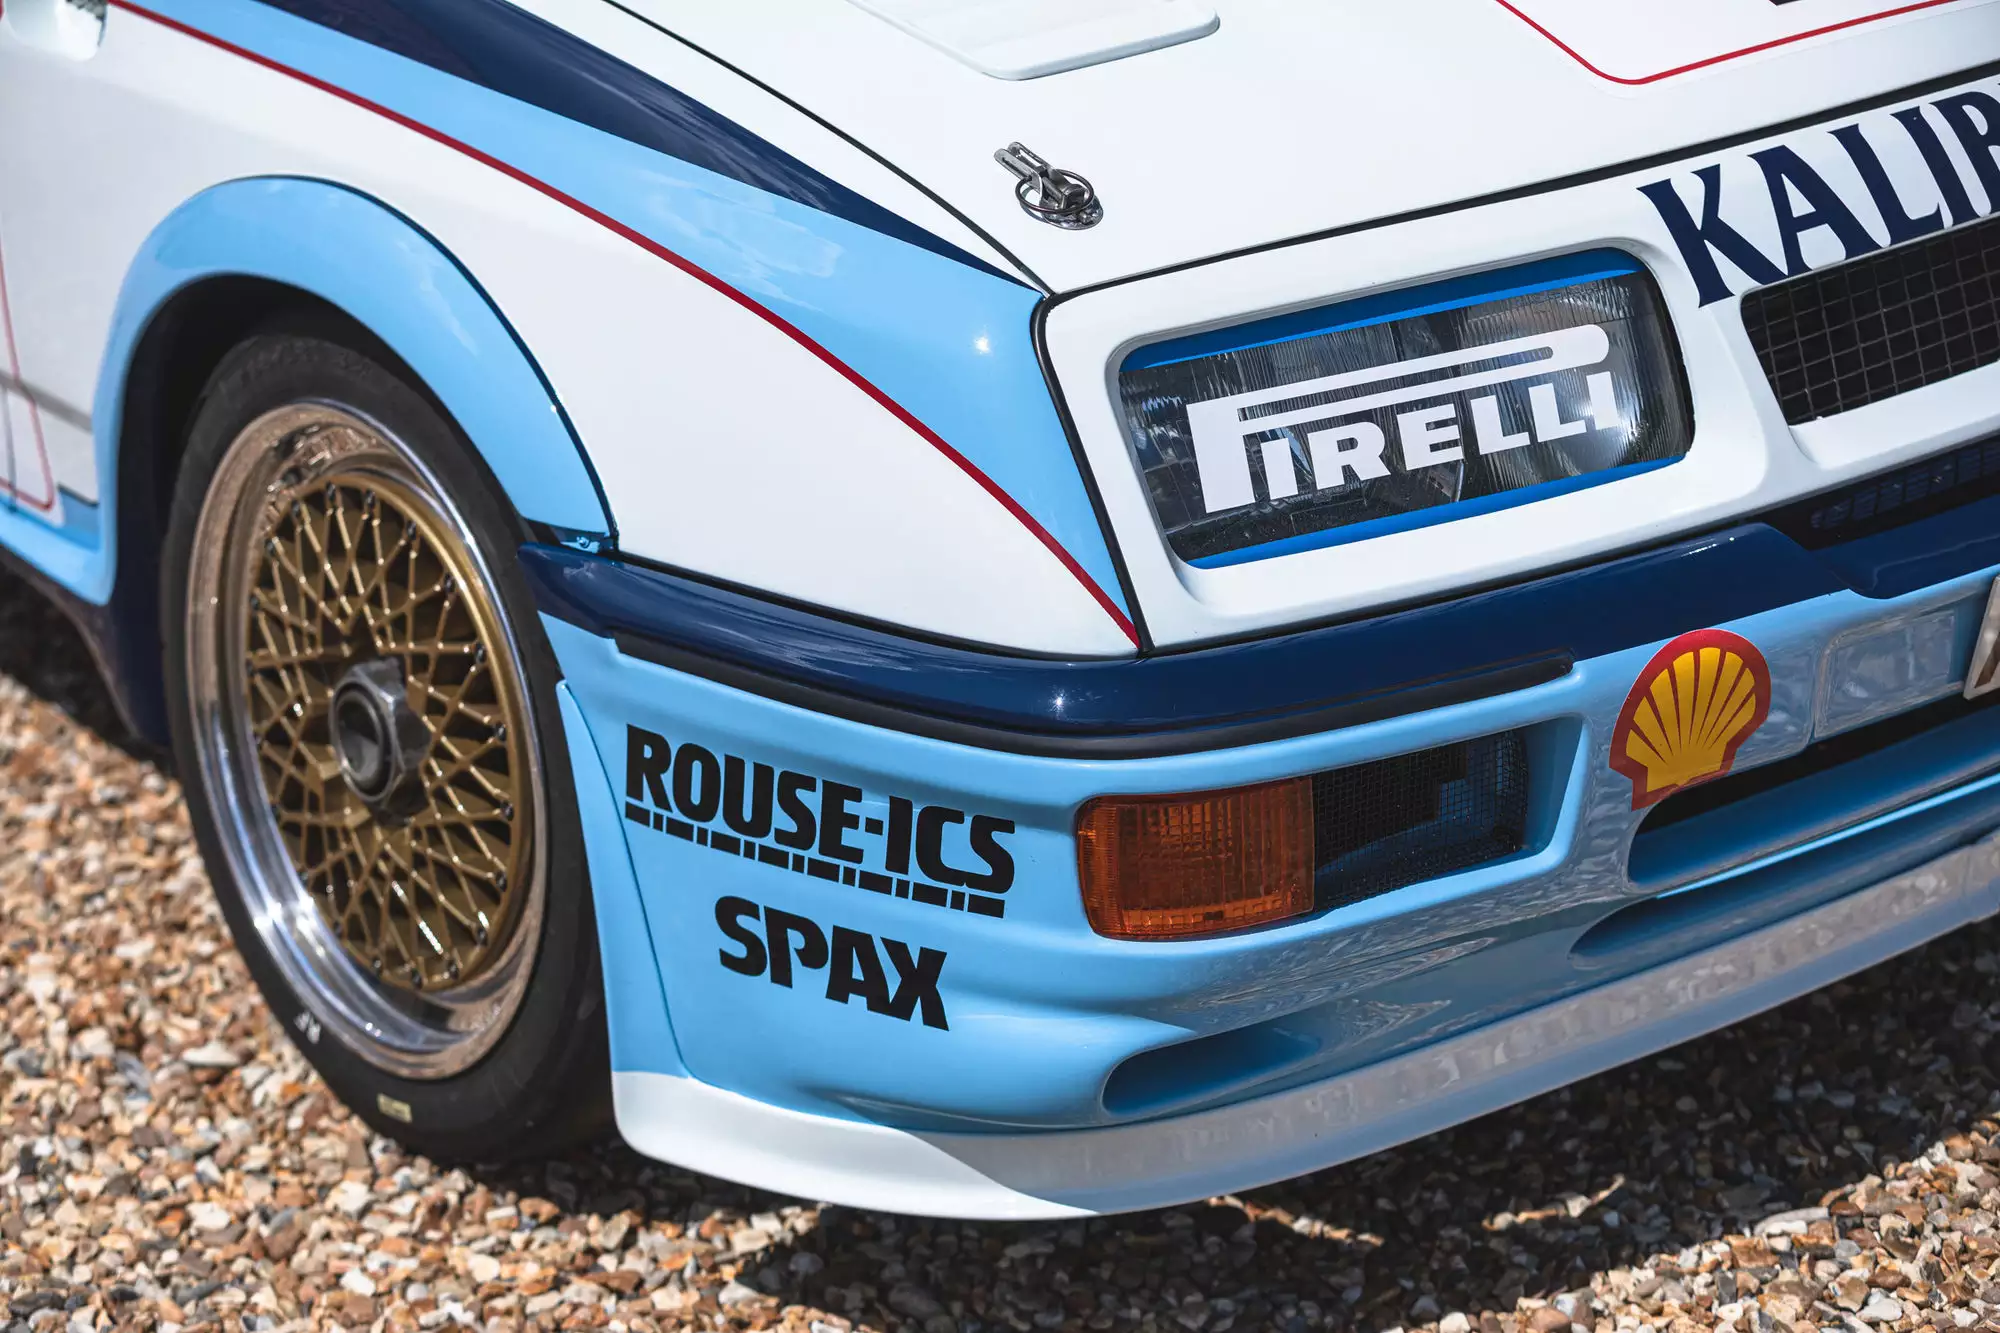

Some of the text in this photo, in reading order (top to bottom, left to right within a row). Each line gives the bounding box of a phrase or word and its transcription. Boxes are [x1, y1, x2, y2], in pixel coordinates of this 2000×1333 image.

[1186, 324, 1619, 513] PIRELLI
[625, 723, 1015, 894] ROUSE-ICS
[714, 895, 949, 1031] SPAX
